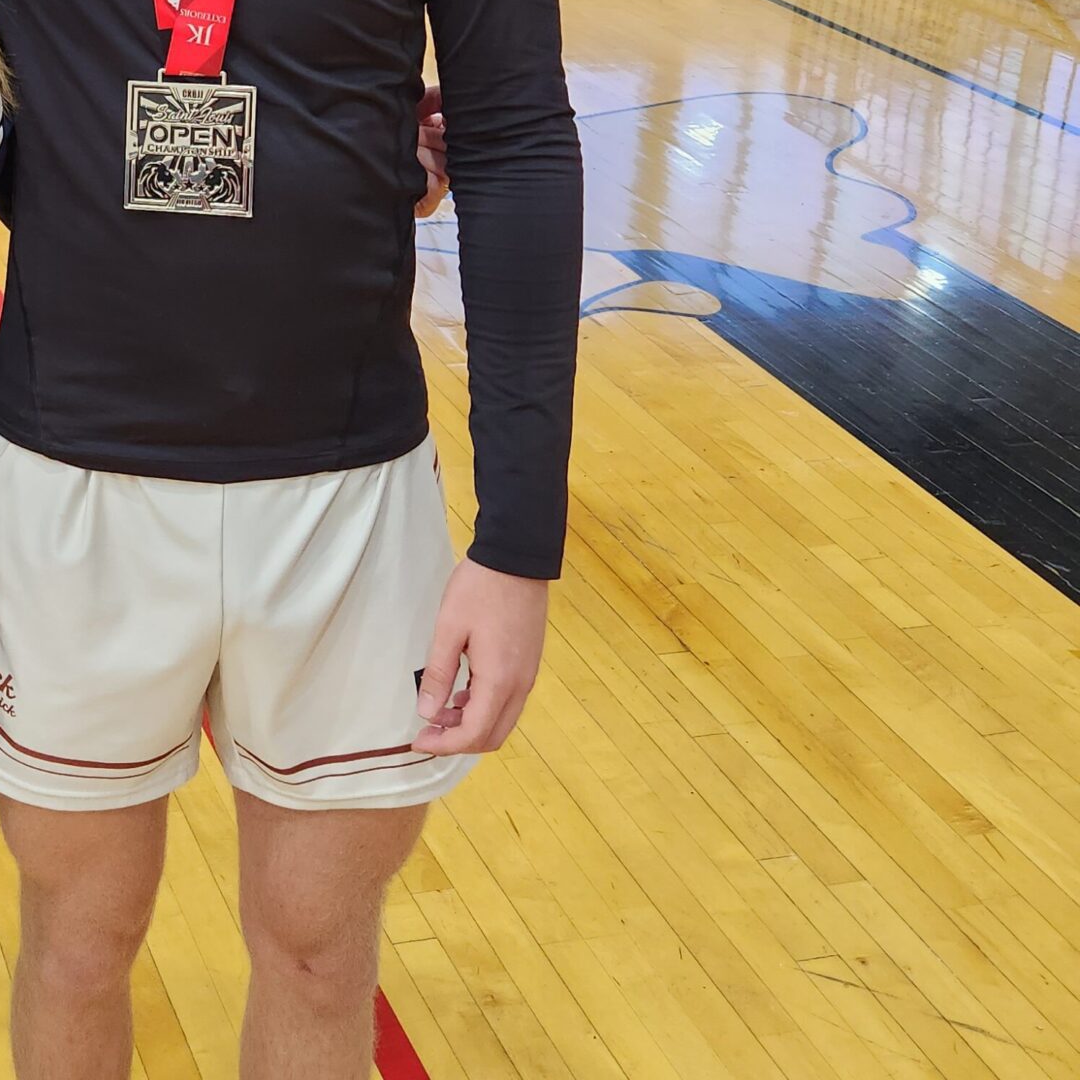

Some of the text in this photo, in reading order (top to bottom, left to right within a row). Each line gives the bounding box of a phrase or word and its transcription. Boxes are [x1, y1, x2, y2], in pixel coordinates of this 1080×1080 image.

[180, 8, 226, 24] EXTERIORS
[187, 23, 216, 46] JK
[148, 103, 197, 121] Saint
[149, 124, 232, 148] OPEN
[147, 144, 235, 158] CHAMPIONSHIP
